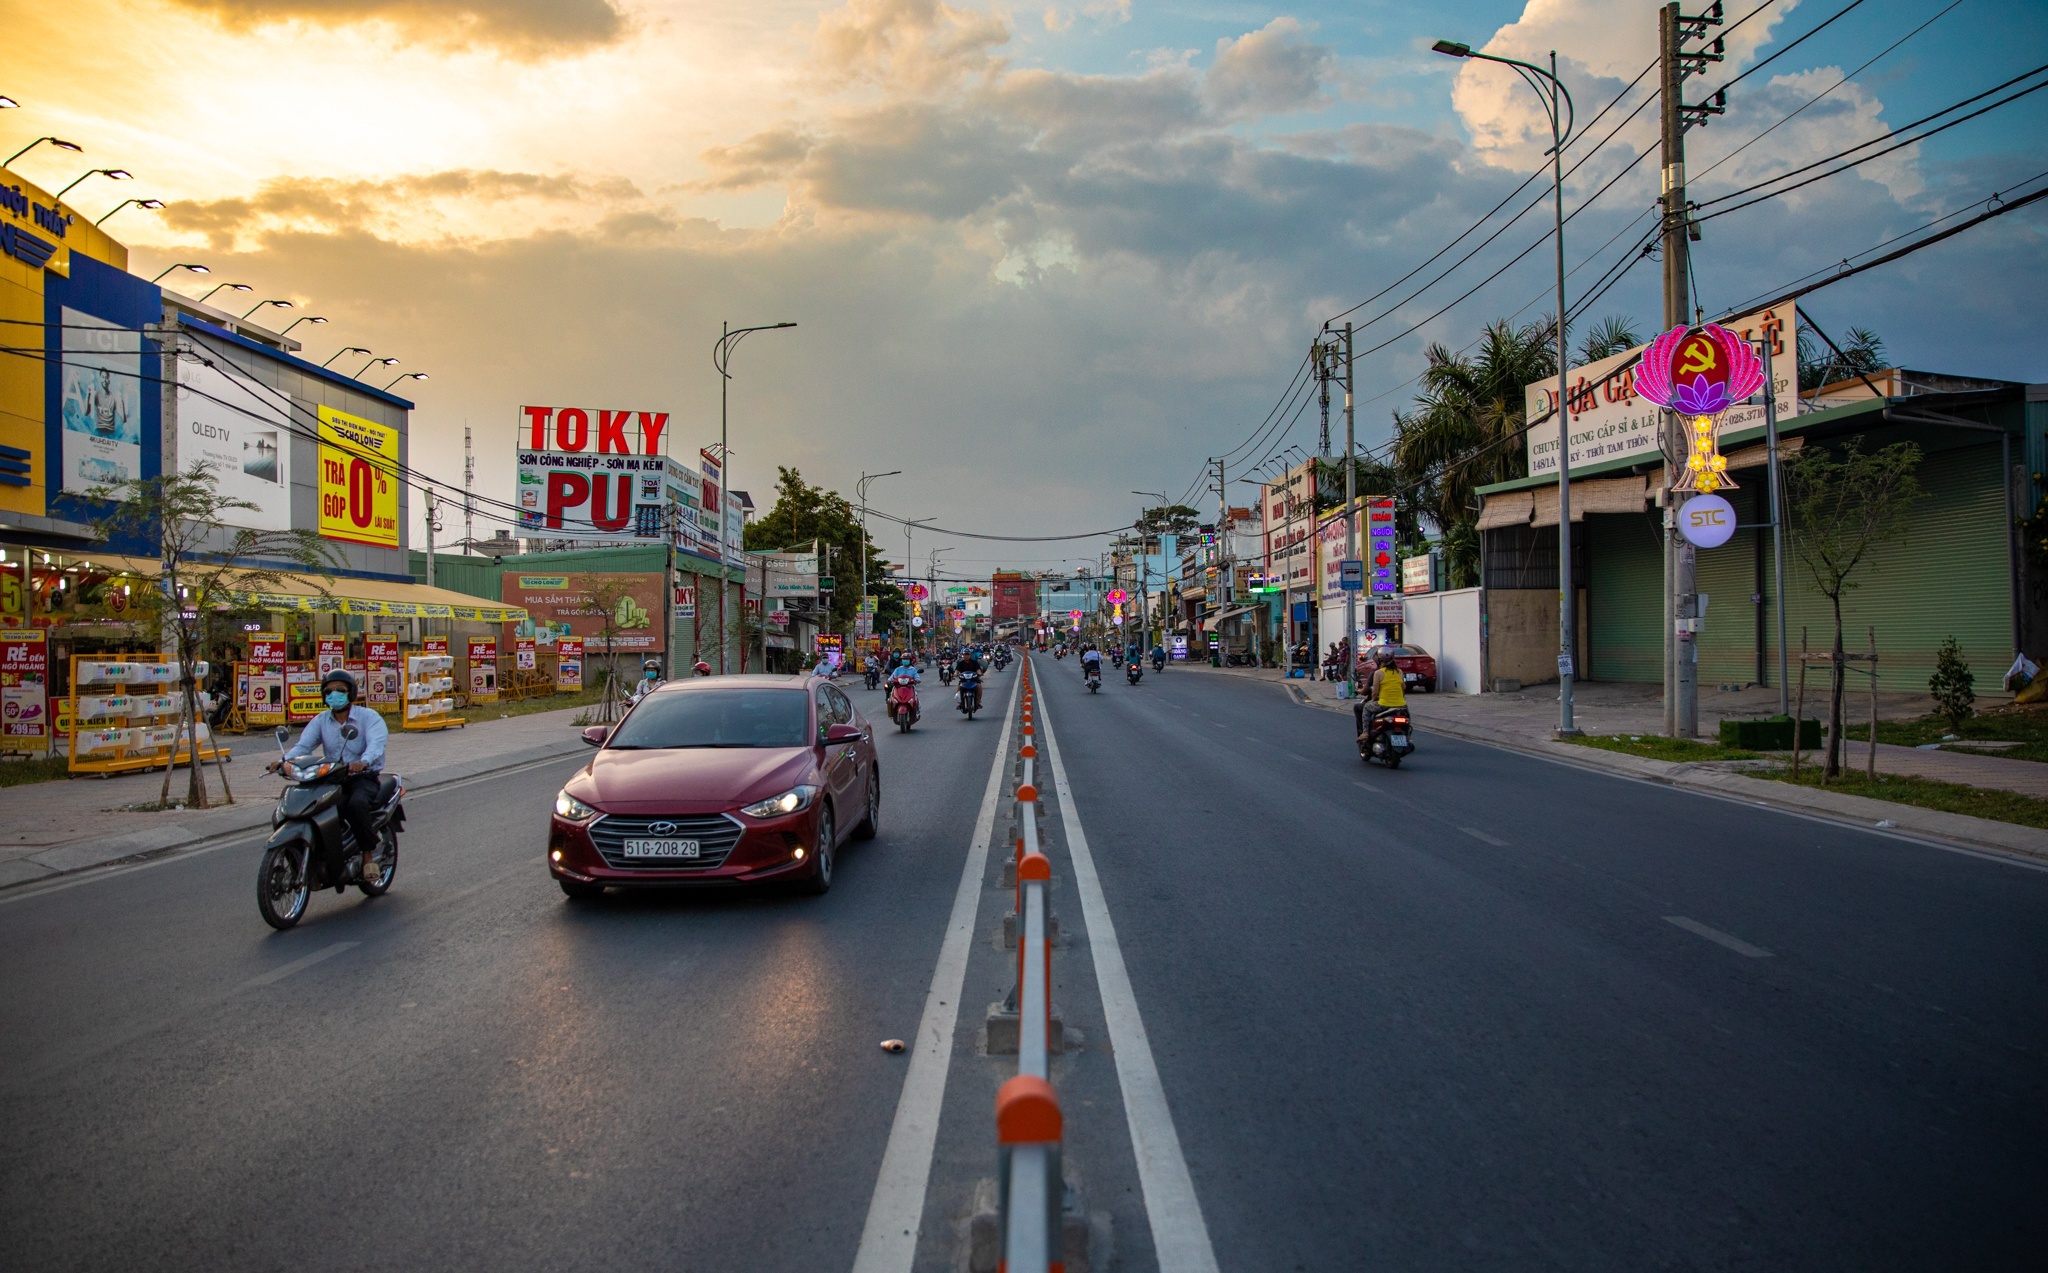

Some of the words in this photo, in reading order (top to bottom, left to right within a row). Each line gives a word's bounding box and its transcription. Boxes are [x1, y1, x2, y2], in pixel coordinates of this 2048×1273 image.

[33, 202, 68, 239] THẤT
[81, 323, 120, 352] TCL
[192, 421, 216, 439] OLED
[218, 428, 230, 442] TV
[524, 406, 670, 456] TOKY
[1533, 437, 1560, 455] CHUYÊ
[1570, 431, 1594, 446] CUNG
[1597, 420, 1616, 438] CẤP
[1631, 419, 1639, 431] &
[1607, 442, 1624, 454] TAM
[1627, 435, 1649, 449] THÔN
[519, 454, 538, 466] SƠN
[539, 453, 564, 467] CÔNG
[566, 455, 599, 470] NGHIỆP
[606, 458, 624, 470] SƠN
[626, 460, 640, 472] MẠ
[324, 457, 346, 486] TRẢ
[643, 479, 659, 487] TOA
[324, 491, 346, 519] GÓP
[546, 469, 635, 532] PU
[1371, 510, 1392, 521] KHÁM
[1690, 509, 1726, 528] STC
[524, 596, 543, 604] MUA
[544, 593, 564, 604] SẮM
[675, 588, 694, 605] OKY
[556, 608, 570, 616] TRẢ
[7, 643, 28, 662] RẺ
[29, 653, 45, 662] ĐẾN
[254, 643, 272, 657] RẺ
[322, 640, 334, 650] RẺ
[371, 643, 386, 655] RẺ
[427, 642, 438, 650] RẺ
[474, 644, 486, 654] RẺ
[562, 642, 574, 651] RẺ
[2, 662, 18, 670] NGỠ
[10, 724, 40, 735] 299.000
[626, 840, 697, 856] 51G-208.29
